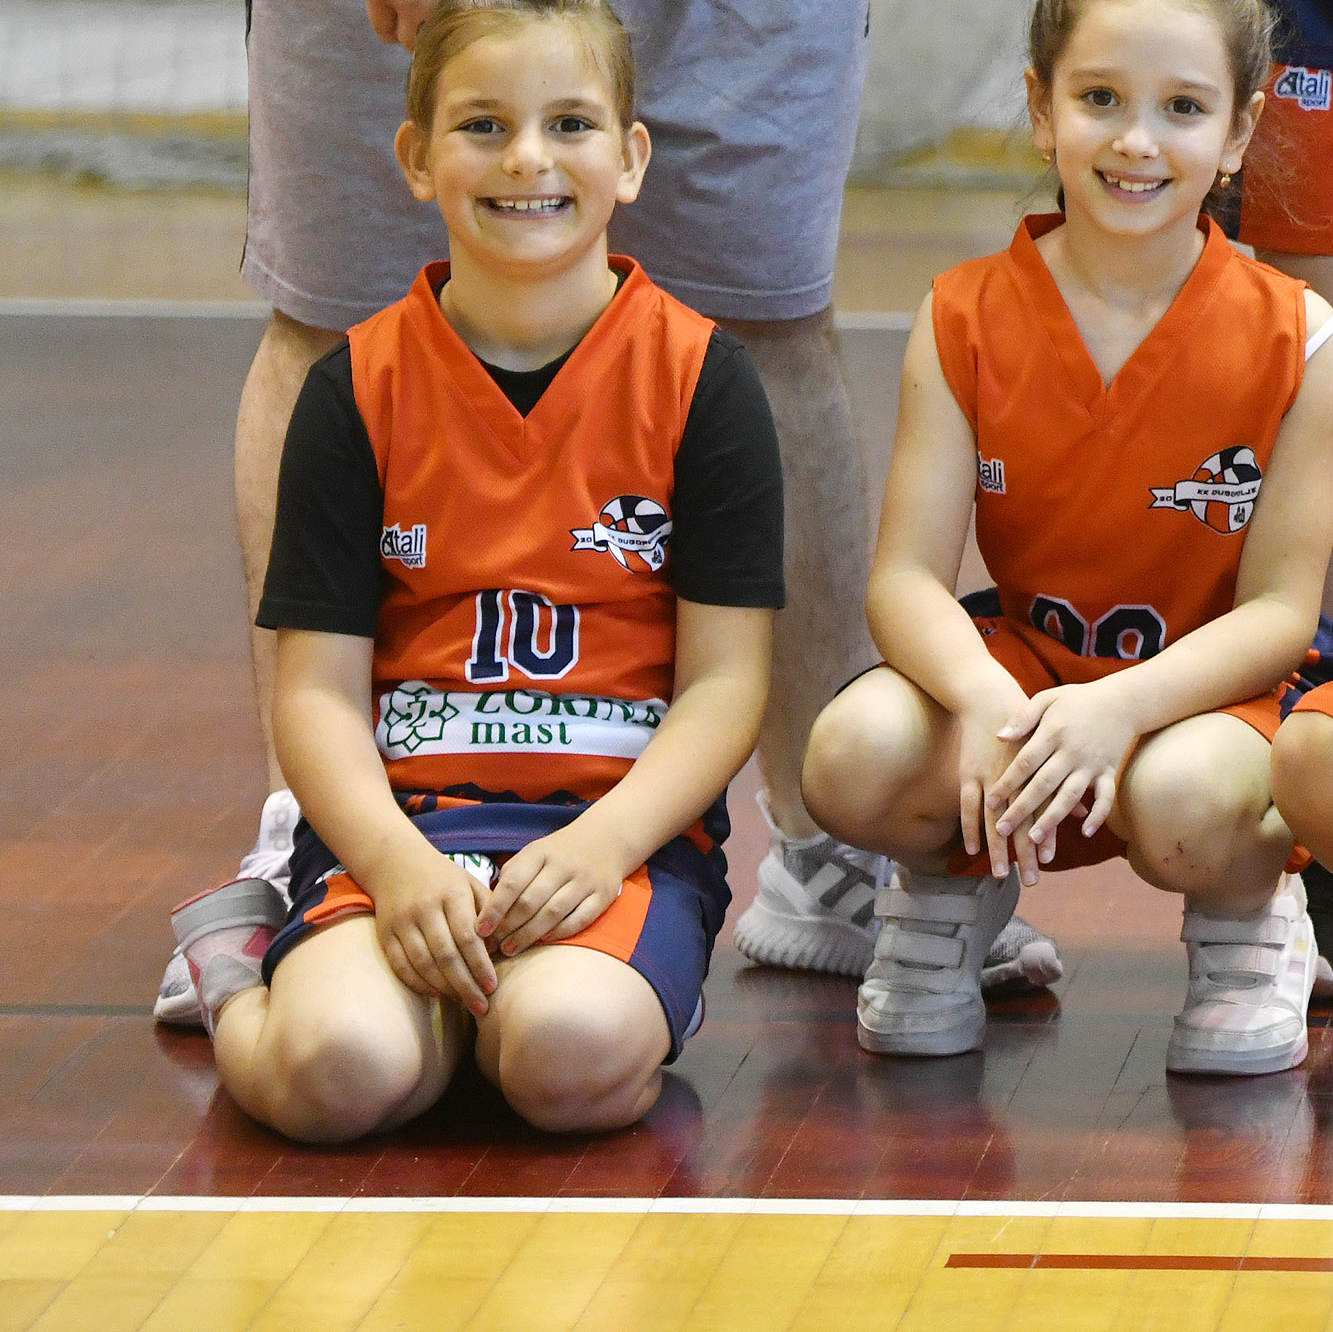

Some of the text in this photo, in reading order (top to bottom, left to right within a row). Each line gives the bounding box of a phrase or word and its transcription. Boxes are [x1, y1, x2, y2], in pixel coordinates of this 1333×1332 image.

[1277, 71, 1329, 96] Atali
[382, 528, 424, 556] Atali
[464, 587, 581, 685] 10
[469, 721, 573, 746] mast
